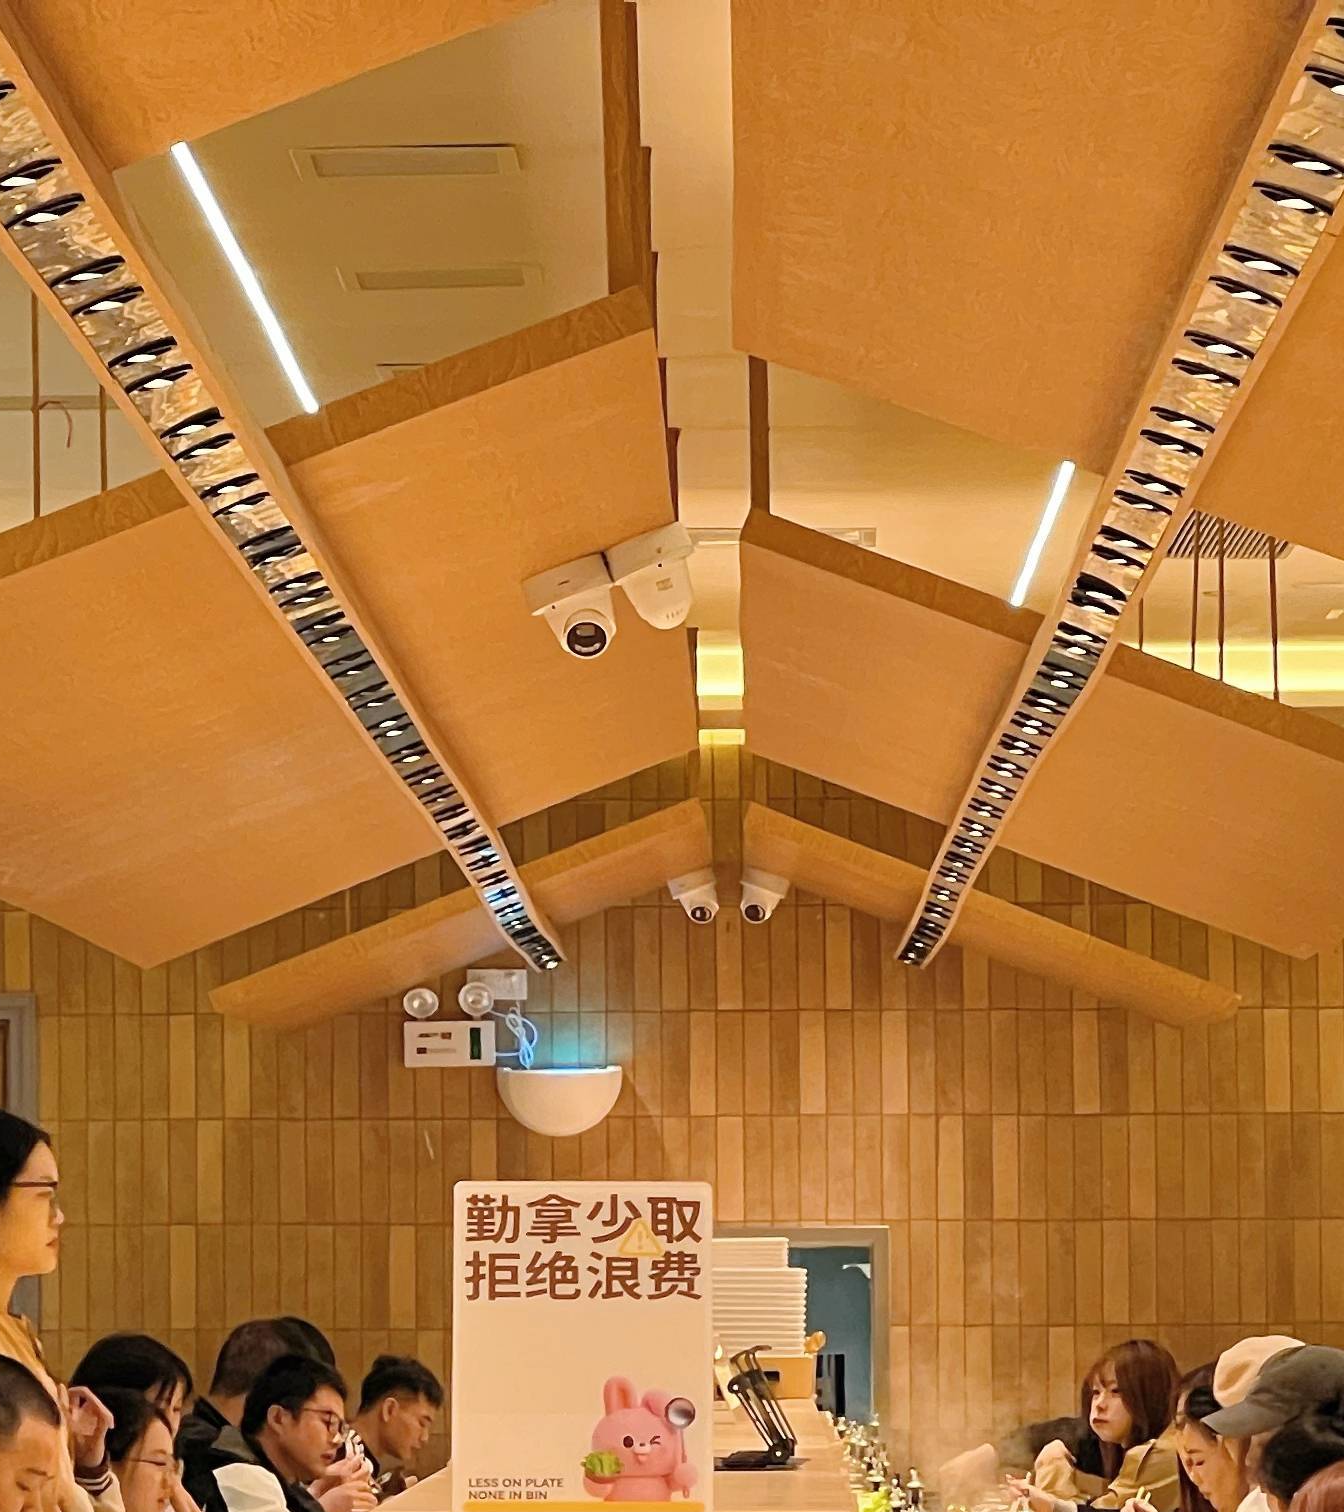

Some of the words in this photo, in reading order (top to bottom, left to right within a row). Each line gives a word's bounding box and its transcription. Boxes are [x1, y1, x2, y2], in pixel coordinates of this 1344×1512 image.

[464, 1193, 703, 1245] 勤拿少取
[464, 1251, 703, 1301] 拒绝浪费
[468, 1478, 499, 1488] LESS
[502, 1478, 522, 1488] ON
[526, 1478, 564, 1488] PLATE
[468, 1490, 505, 1500] NONE
[509, 1490, 522, 1500] IN
[526, 1490, 548, 1500] BIN
